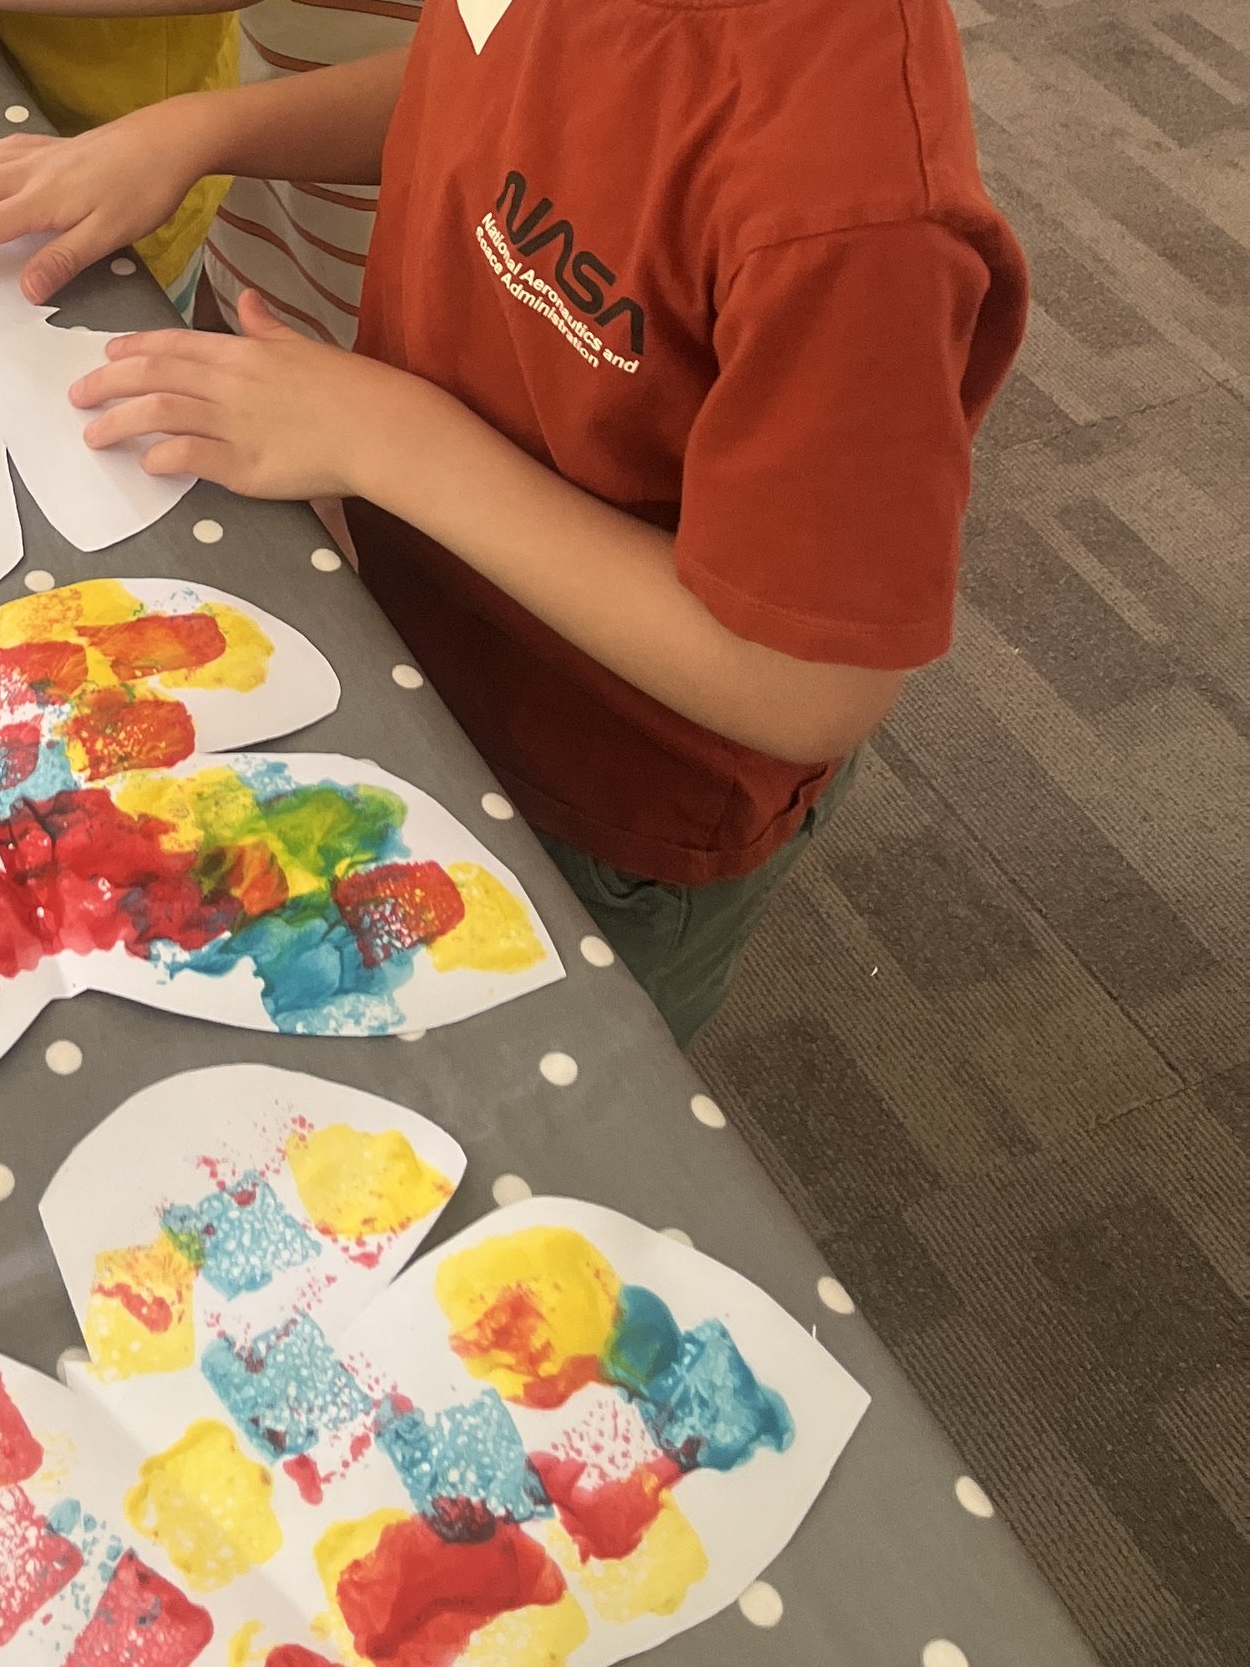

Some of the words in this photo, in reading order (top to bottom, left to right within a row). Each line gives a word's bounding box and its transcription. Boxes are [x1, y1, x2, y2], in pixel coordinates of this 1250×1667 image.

[475, 226, 503, 275] Space
[500, 273, 600, 369] Administration
[482, 212, 523, 275] National
[519, 269, 603, 352] Aeronautics
[602, 346, 640, 375] and
[495, 170, 645, 356] NASA
